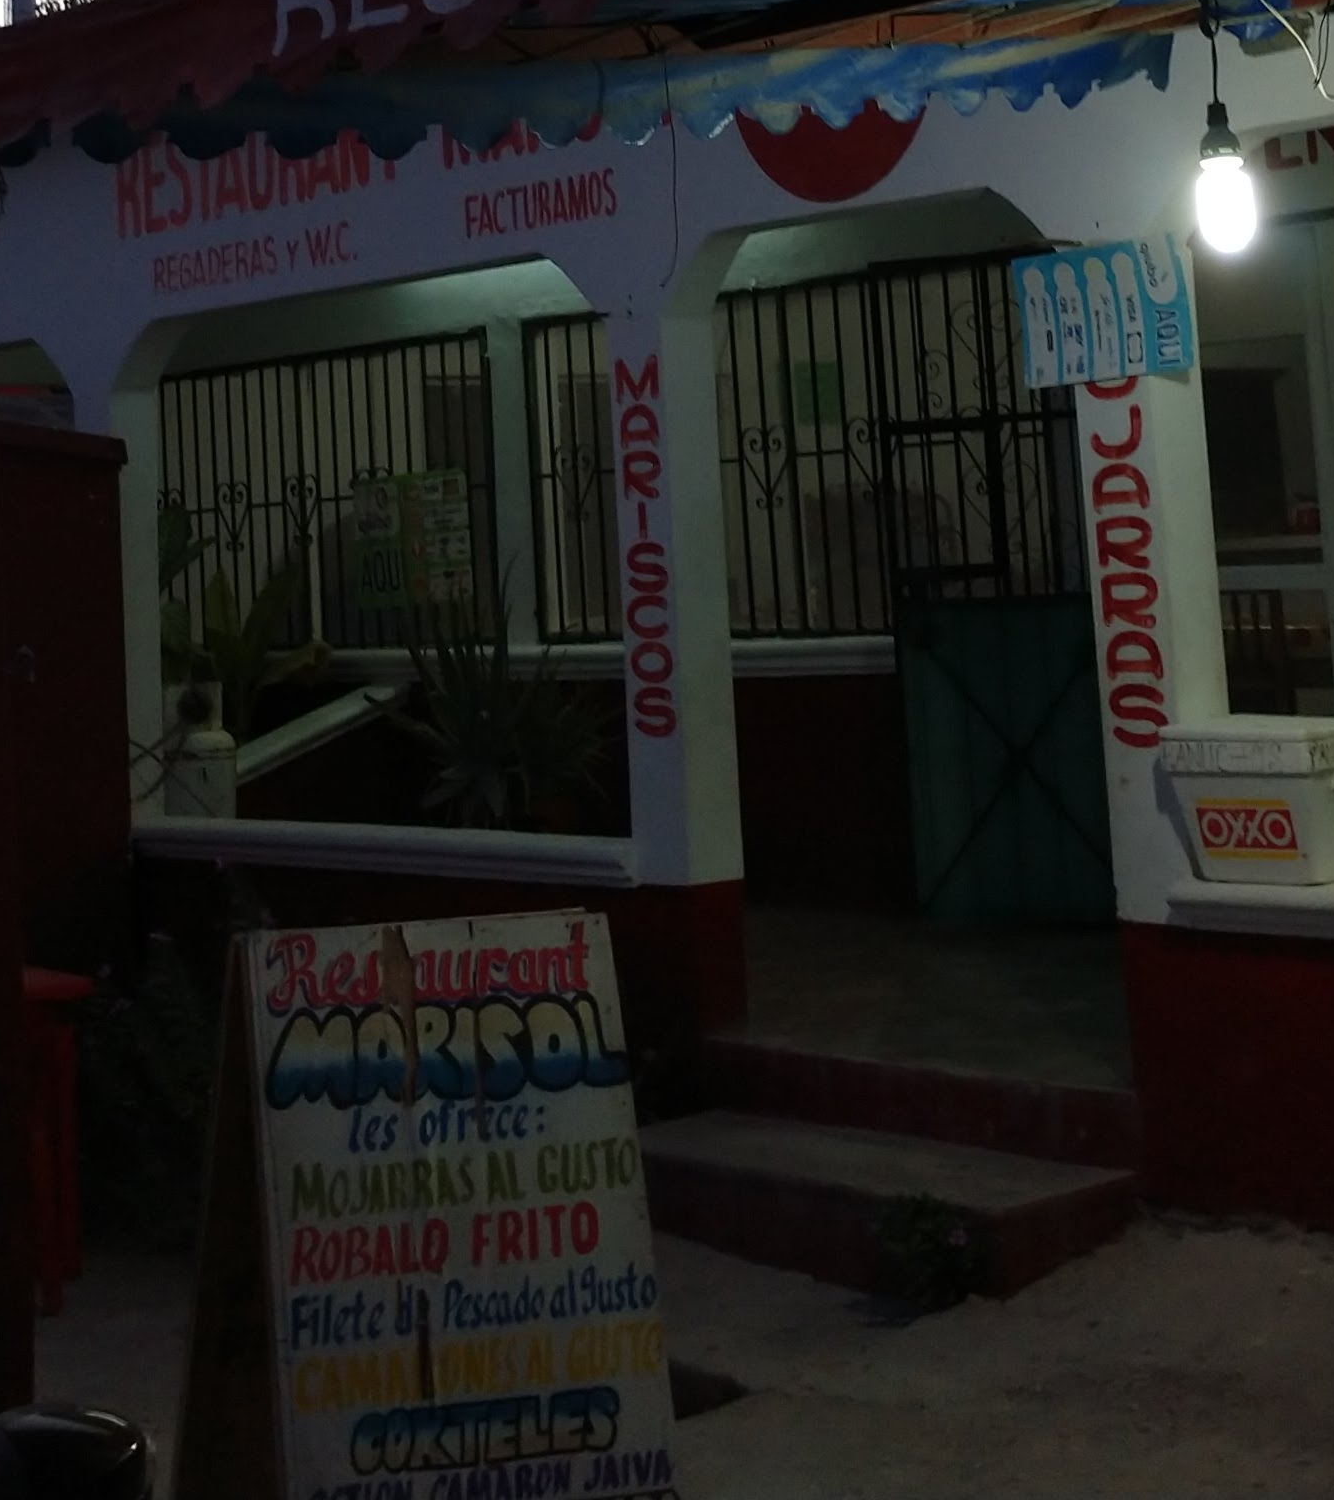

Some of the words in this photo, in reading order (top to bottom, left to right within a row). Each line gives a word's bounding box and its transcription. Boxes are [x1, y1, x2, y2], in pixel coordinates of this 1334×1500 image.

[117, 128, 396, 240] RESTAURAN
[465, 168, 618, 238] FACTURAMOS
[153, 235, 278, 294] REGADERAS
[285, 234, 300, 272] Y
[308, 221, 359, 265] W.C.
[615, 352, 677, 738] MARISCOS
[1082, 376, 1170, 748] JARRAS
[1200, 810, 1293, 847] OXXO
[267, 921, 590, 1013] Resaurant
[267, 993, 632, 1110] MARISOL
[291, 1154, 475, 1220] MOJARRAS
[486, 1150, 526, 1204] AL
[536, 1138, 638, 1195] GUSTO
[290, 1218, 450, 1286] ROBALO
[471, 1201, 600, 1267] FRITO
[291, 1290, 386, 1350] Filete
[443, 1279, 546, 1330] Pescado
[549, 1268, 577, 1319] al
[293, 1333, 519, 1412] CAMAONES
[351, 1387, 620, 1476] COKTELES
[430, 1456, 570, 1500] CAMARON
[583, 1447, 675, 1491] JAIVA
